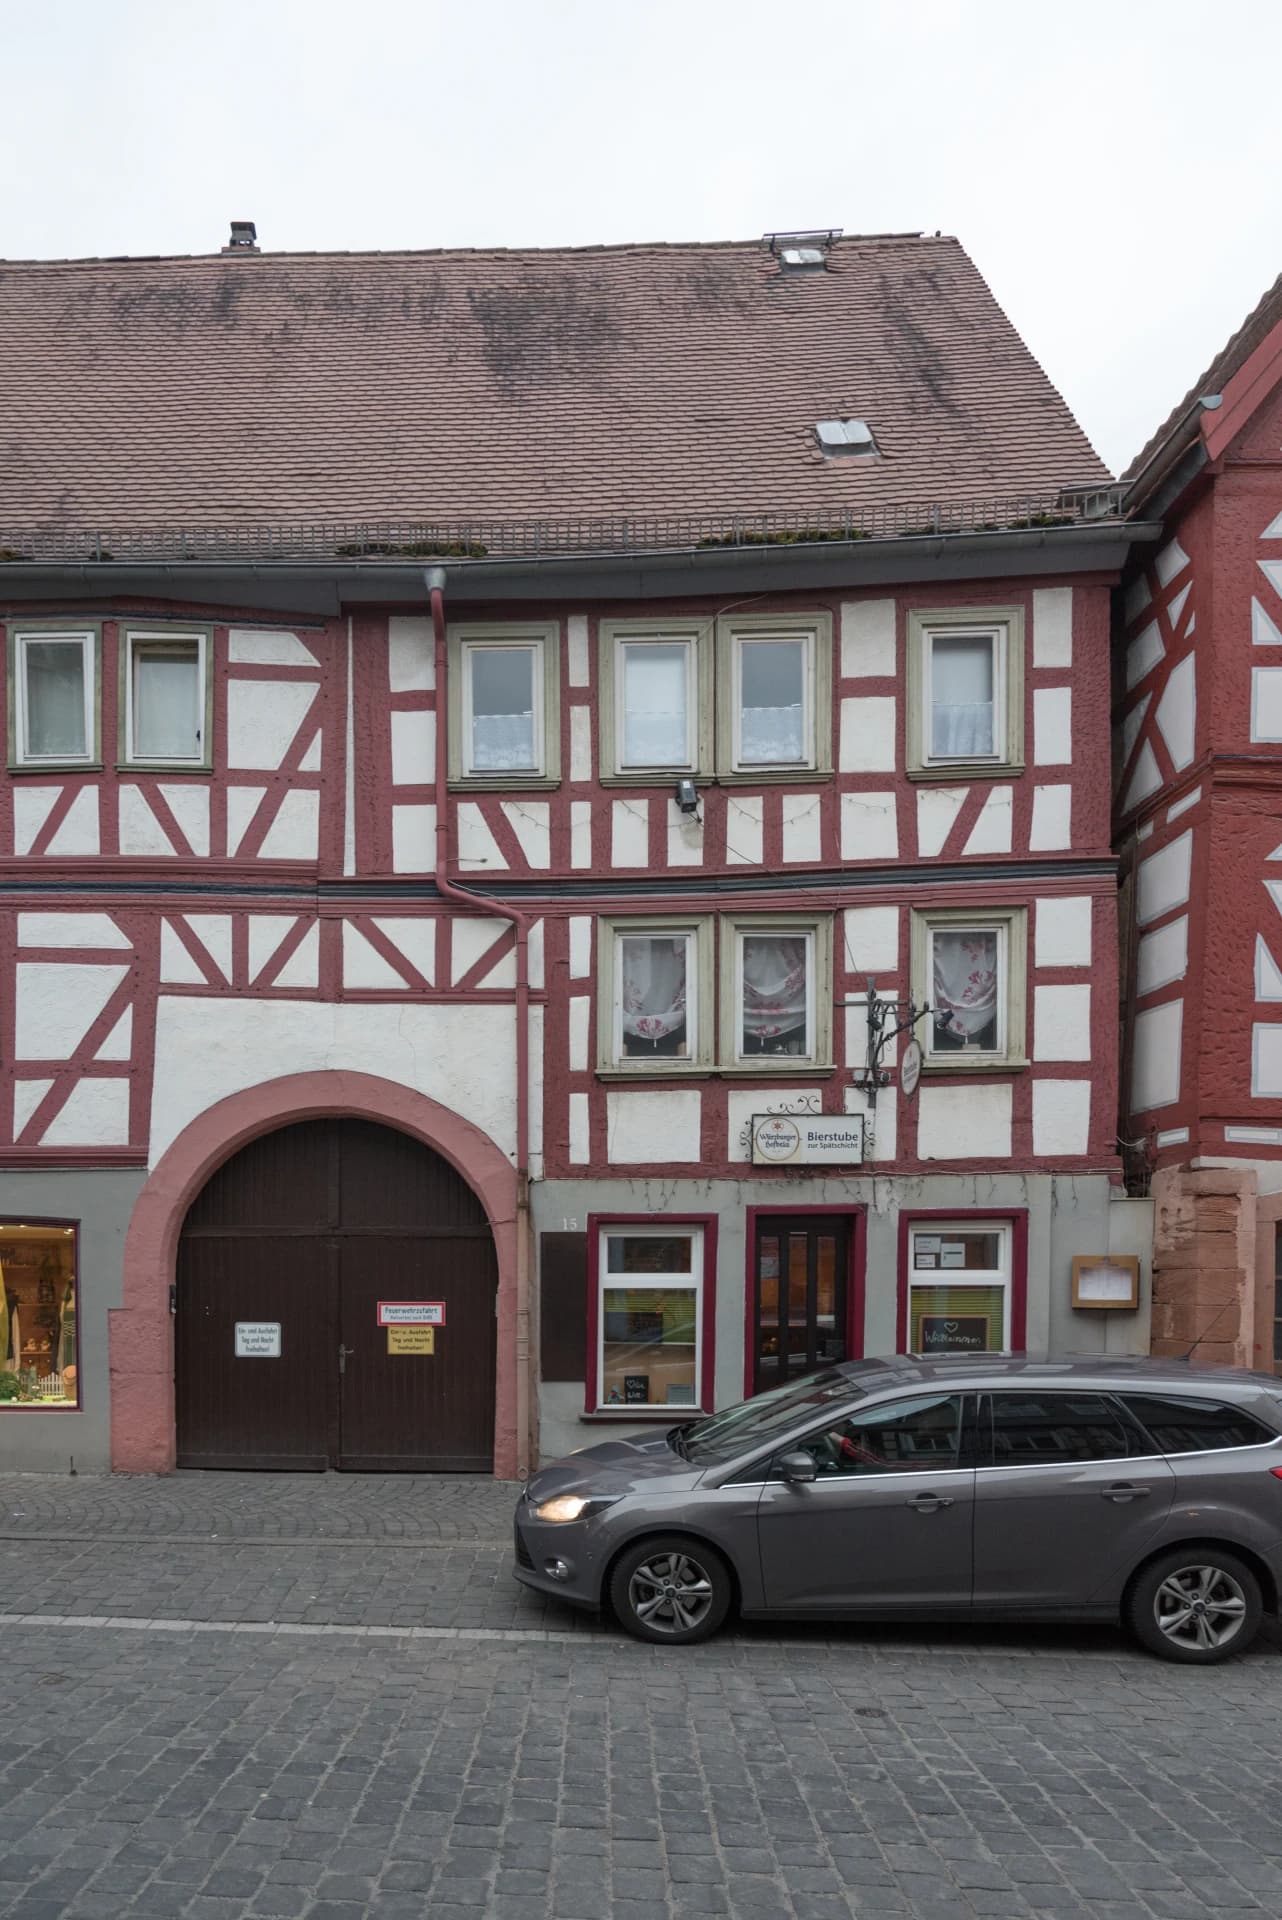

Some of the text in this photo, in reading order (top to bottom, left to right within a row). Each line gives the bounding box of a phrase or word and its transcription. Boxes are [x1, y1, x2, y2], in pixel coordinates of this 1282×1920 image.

[759, 1133, 796, 1143] Würzburger
[807, 1131, 859, 1142] Bierstube
[819, 1142, 858, 1150] Spätschicht
[563, 1217, 577, 1231] 15
[384, 1306, 439, 1314] Feuerwehrzufahrt
[241, 1336, 250, 1344] Tag
[260, 1336, 274, 1344] Nacht
